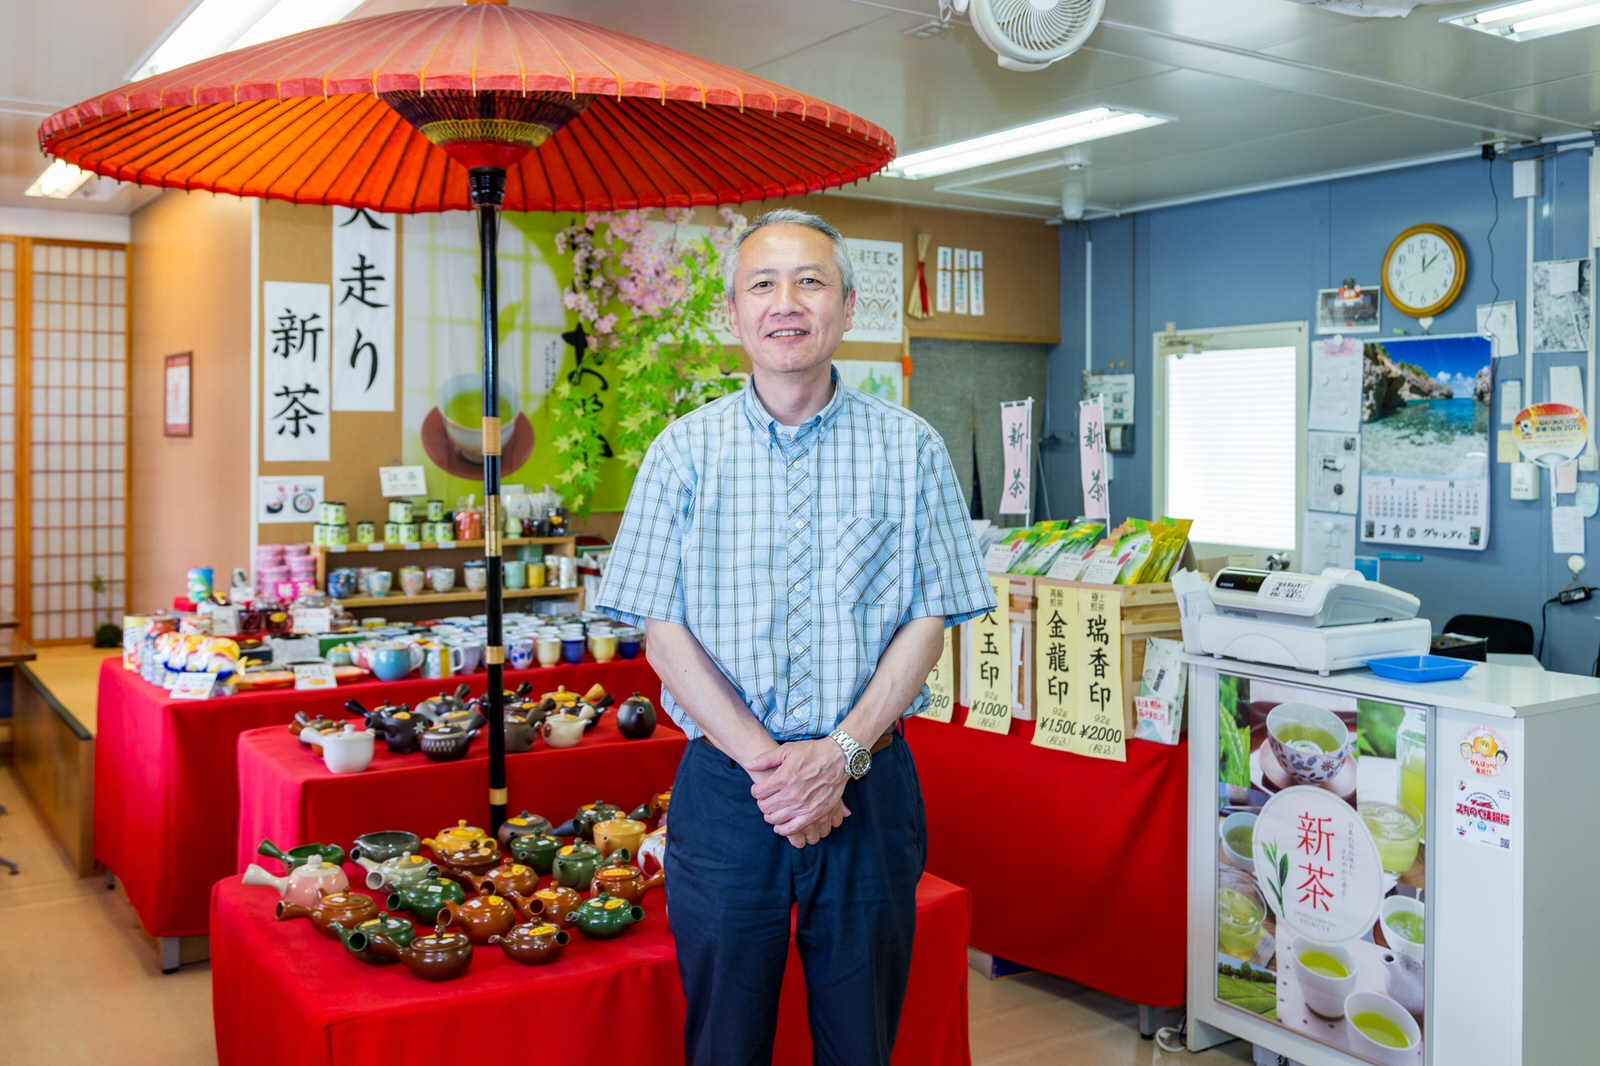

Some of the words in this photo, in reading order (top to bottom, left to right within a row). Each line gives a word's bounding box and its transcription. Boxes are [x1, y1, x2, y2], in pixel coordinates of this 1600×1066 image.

[1441, 248, 1449, 260] 2
[271, 307, 325, 439] 新茶
[1008, 422, 1026, 499] 新茶
[1083, 421, 1105, 503] 新茶
[1046, 609, 1069, 705] 金龍印
[1086, 614, 1111, 712] 瑞香印
[1079, 724, 1123, 744] ¥2000
[1296, 811, 1336, 912] 新茶
